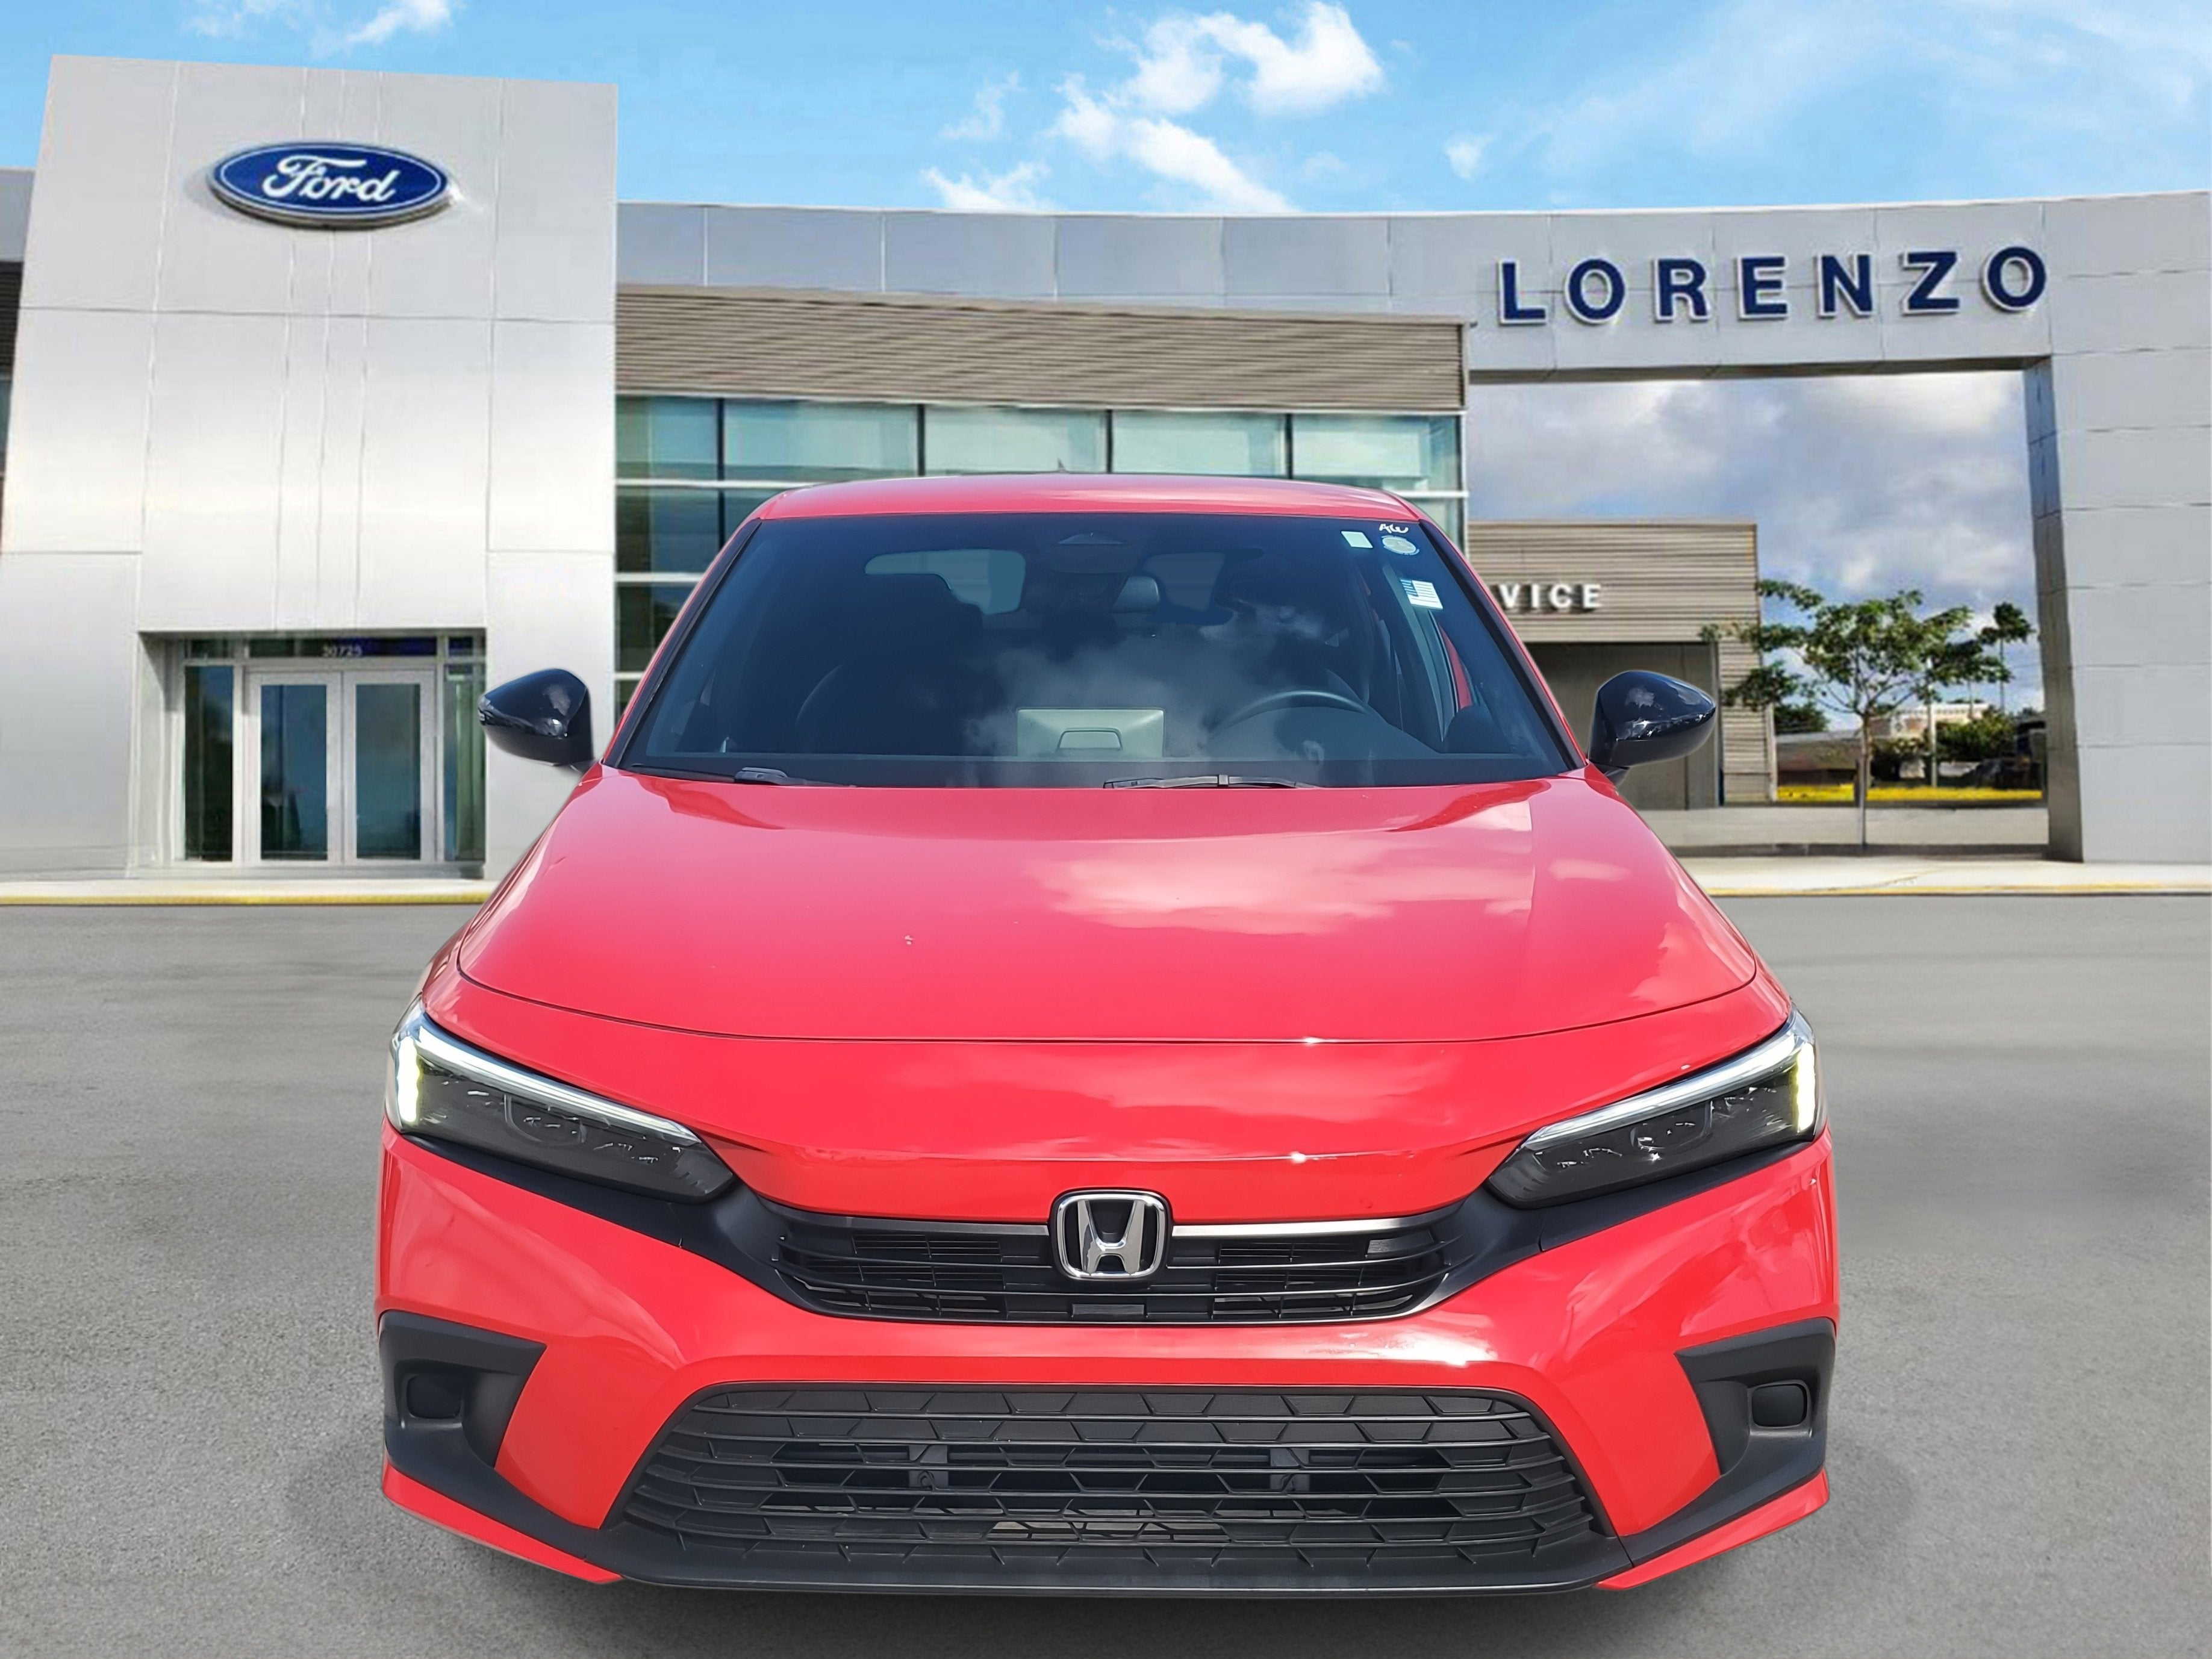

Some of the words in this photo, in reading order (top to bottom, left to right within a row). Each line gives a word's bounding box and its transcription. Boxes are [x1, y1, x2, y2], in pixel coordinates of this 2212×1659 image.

[261, 154, 400, 201] Ford
[1497, 245, 2048, 325] LORENZO
[1498, 583, 1602, 609] VICE
